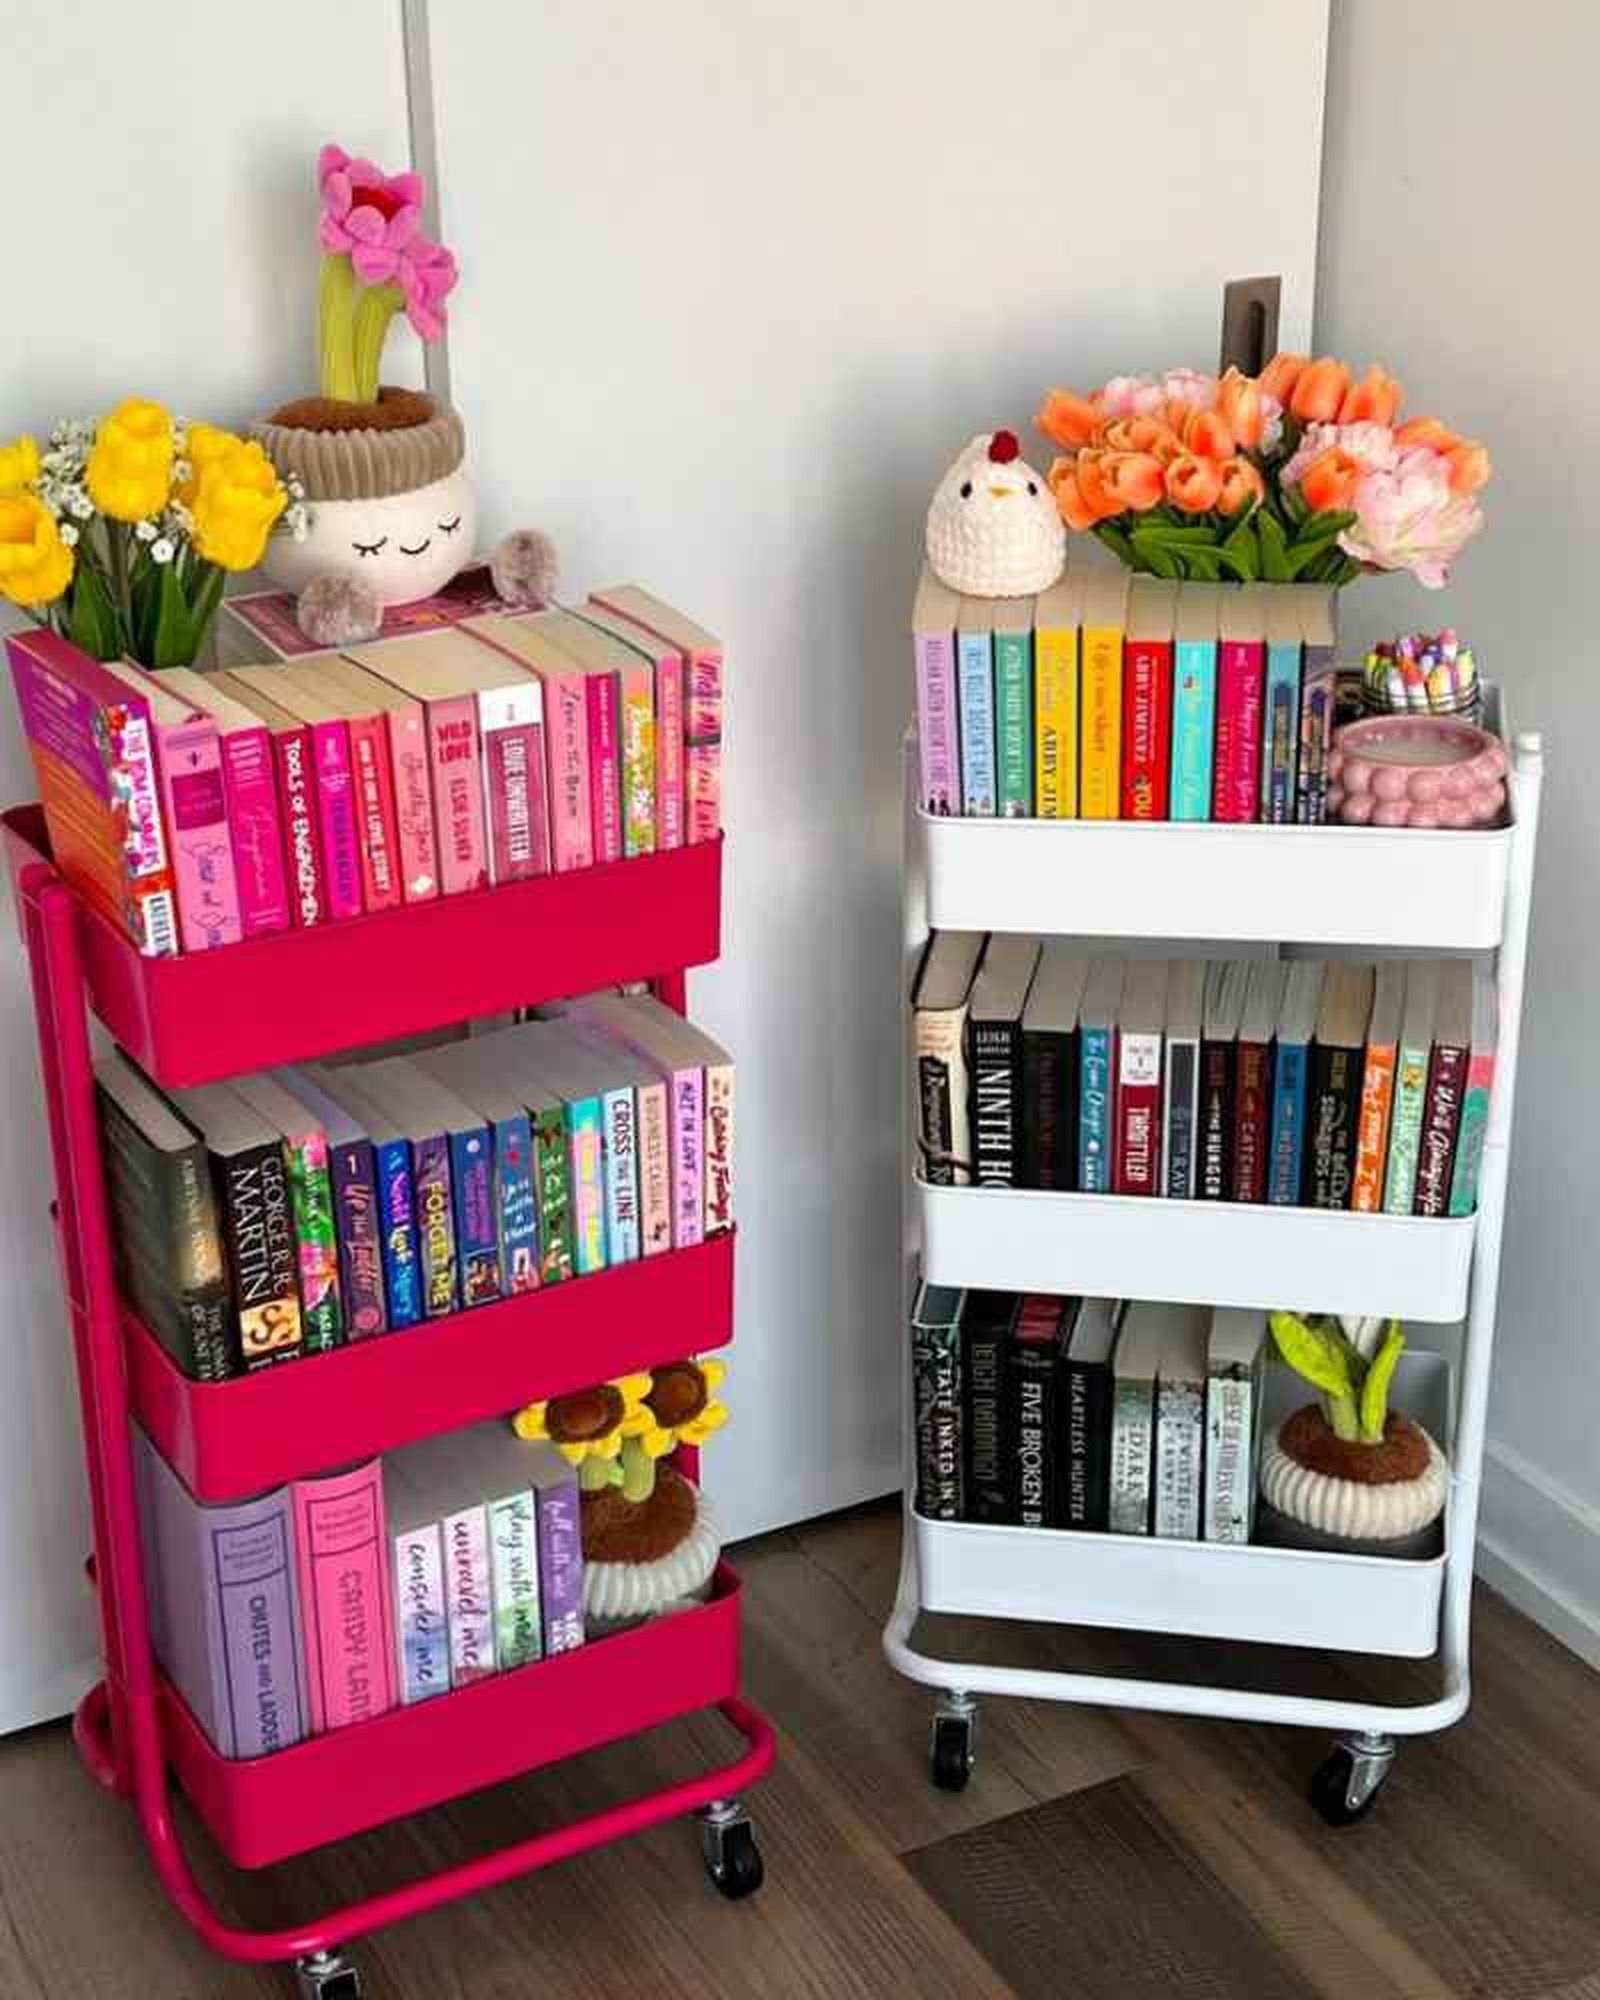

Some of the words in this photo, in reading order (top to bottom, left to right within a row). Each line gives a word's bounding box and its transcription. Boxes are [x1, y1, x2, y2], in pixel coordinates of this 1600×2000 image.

[1136, 655, 1151, 690] ABBY
[437, 719, 471, 741] WILD
[502, 736, 527, 777] LOVE
[1040, 726, 1056, 777] ABBY
[1135, 697, 1150, 764] JIMENEZ
[284, 738, 305, 791] TOOLS
[291, 795, 307, 814] OF
[449, 778, 469, 814] ELSIE
[504, 777, 530, 862] UNWRITTEN
[367, 814, 385, 846] LOVE
[452, 819, 471, 862] SILVER
[373, 848, 390, 892] STORY
[612, 1099, 632, 1156] CROSS
[977, 1068, 1012, 1151] NINTH
[1206, 1133, 1221, 1196] HUNGER
[1238, 1122, 1255, 1201] CATCHING
[262, 1156, 289, 1249] GEORGE
[425, 1181, 449, 1268] FORGET
[616, 1186, 634, 1224] LINE
[231, 1167, 271, 1302] MARTIN
[431, 1272, 451, 1306] ME
[937, 1368, 951, 1409] FATE
[971, 1343, 996, 1392] LEIGH
[1021, 1381, 1043, 1425] FIVE
[1071, 1373, 1087, 1455] HEARTLESS
[938, 1417, 953, 1474] INKED
[1018, 1427, 1044, 1505] BROKEN
[1127, 1430, 1145, 1492] DARK
[1071, 1459, 1086, 1520] HUNTER
[496, 1500, 530, 1549] play
[407, 1543, 435, 1634] consider
[454, 1520, 488, 1618] unravel
[510, 1556, 531, 1600] with
[249, 1594, 272, 1661] CHUTES
[339, 1569, 367, 1655] CANDY
[513, 1606, 529, 1644] me
[416, 1645, 432, 1681] me
[461, 1626, 477, 1666] me
[348, 1657, 371, 1720] LAN
